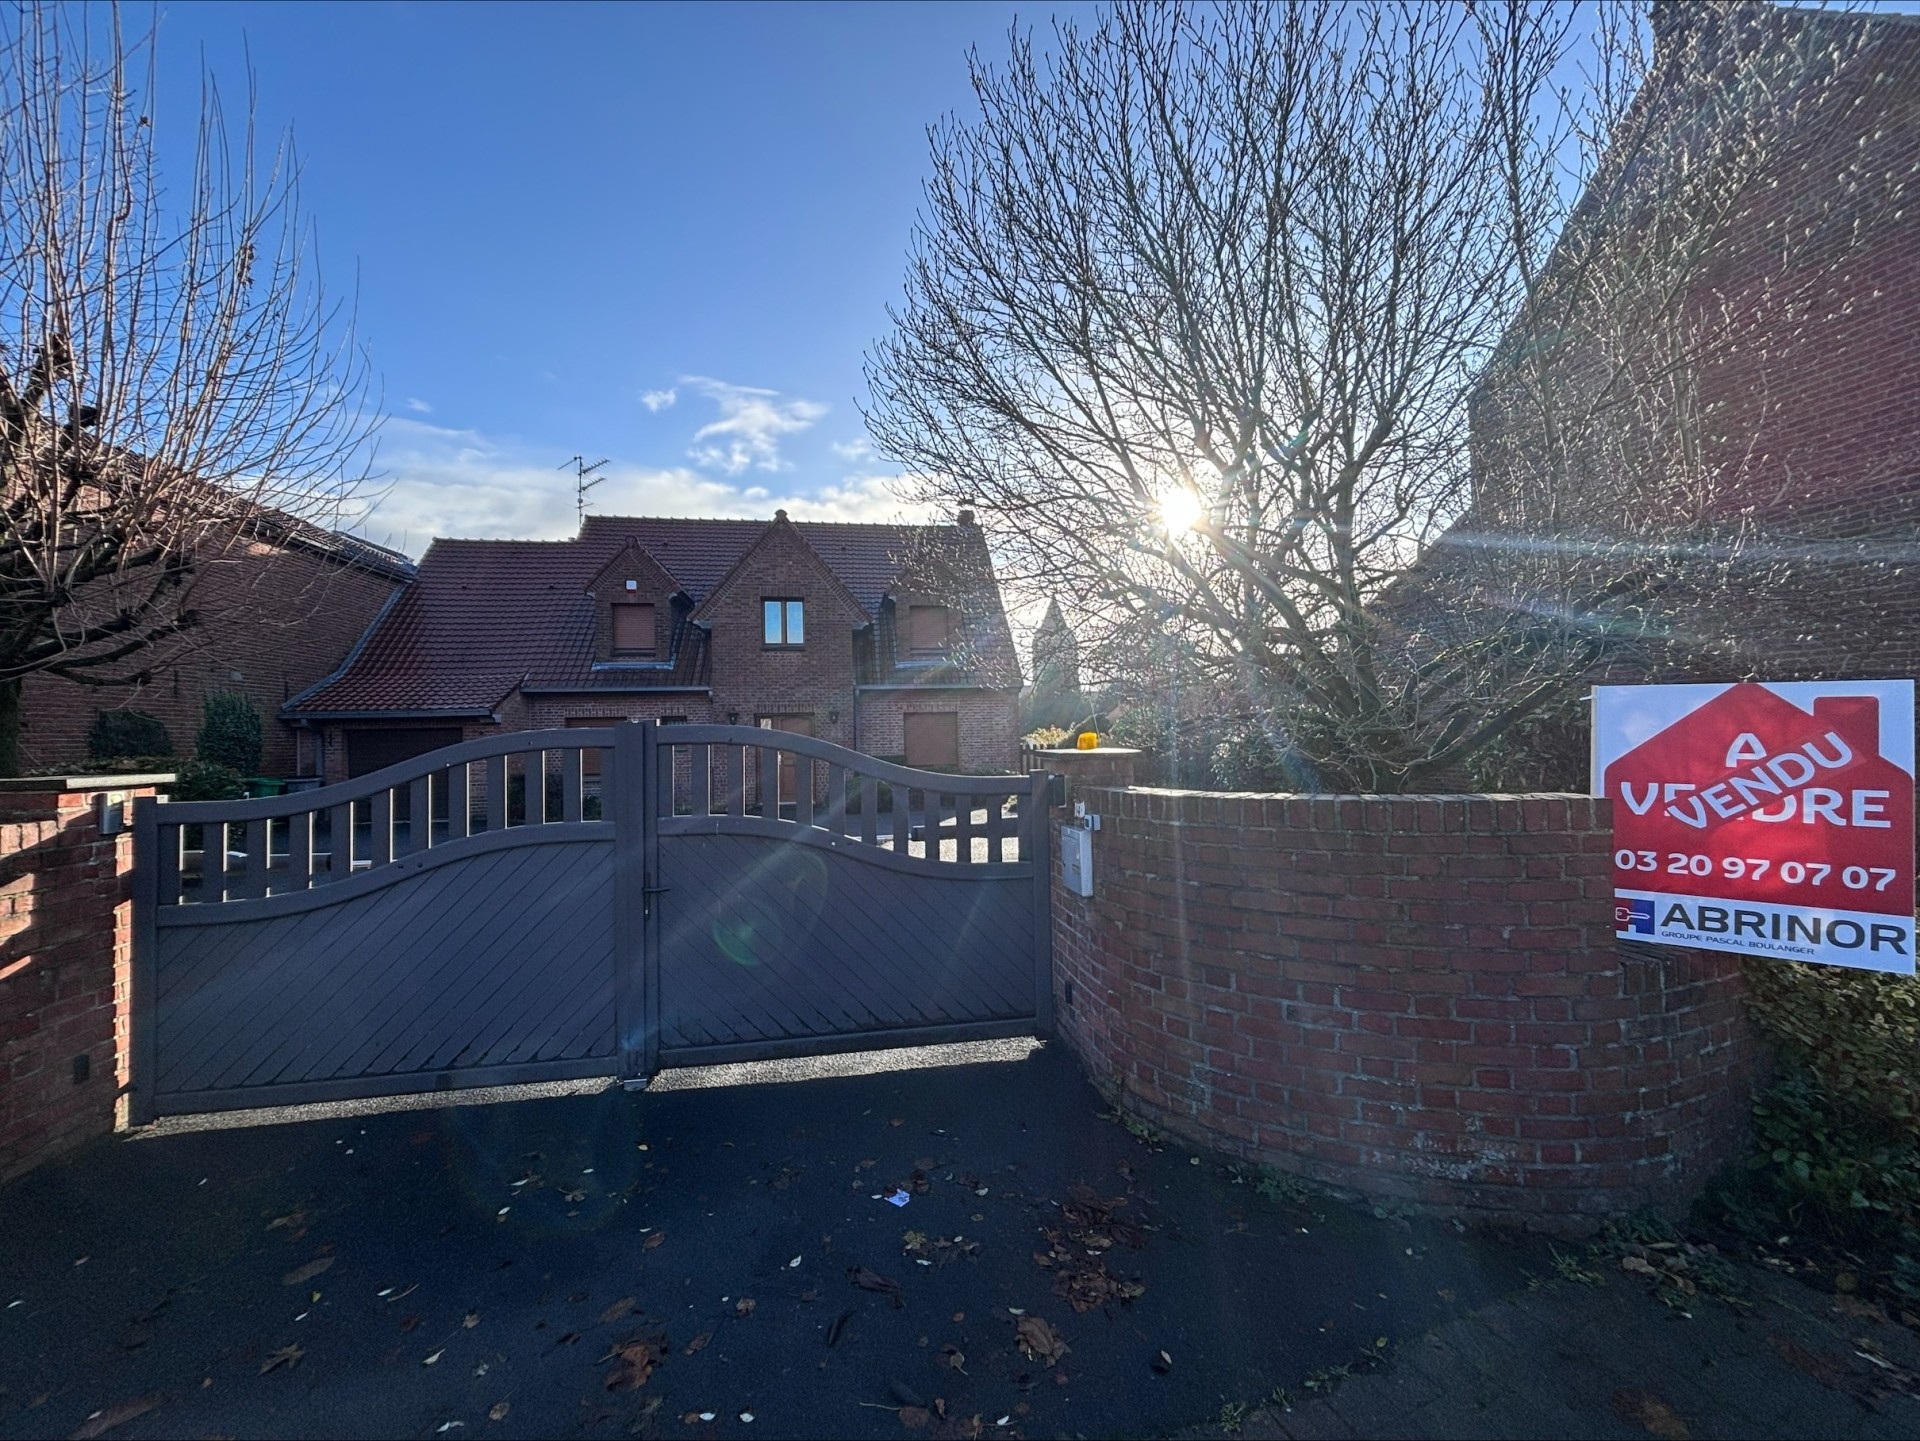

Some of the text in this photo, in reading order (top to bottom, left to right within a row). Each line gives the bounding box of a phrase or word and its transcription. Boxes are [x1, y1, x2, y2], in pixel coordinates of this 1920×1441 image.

[1725, 732, 1768, 768] A
[1666, 731, 1853, 829] VENDU
[1620, 781, 1891, 828] VDRE
[1614, 849, 1896, 892] 03 20 97 07 07
[1660, 902, 1909, 956] ABRINOR
[1661, 930, 1815, 956] GROUPE PASCAL BOULANGER
